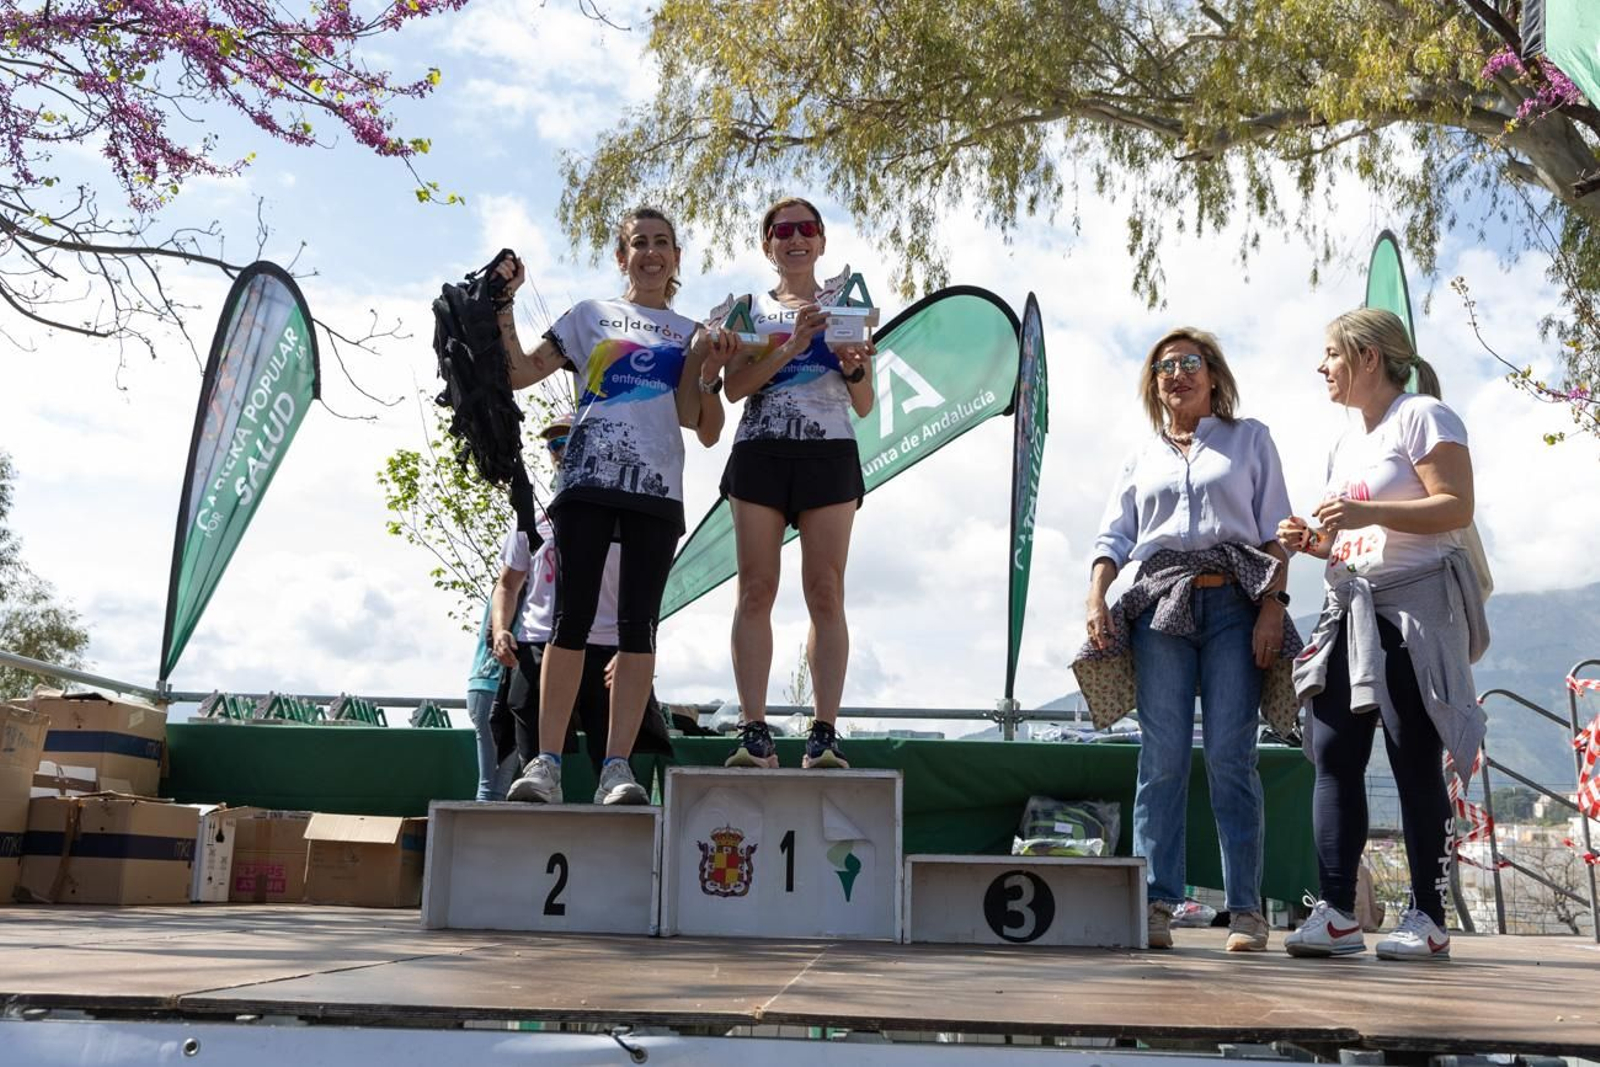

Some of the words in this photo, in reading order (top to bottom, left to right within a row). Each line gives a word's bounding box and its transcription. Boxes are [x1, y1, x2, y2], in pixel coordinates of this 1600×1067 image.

[599, 316, 683, 339] calderón
[243, 327, 299, 423] POPULAR
[235, 392, 295, 505] SALUD
[861, 449, 898, 477] unta
[901, 436, 920, 453] de
[923, 390, 996, 440] Andalucía
[543, 852, 569, 916] 2
[780, 830, 795, 892] 1
[1003, 874, 1036, 939] 3
